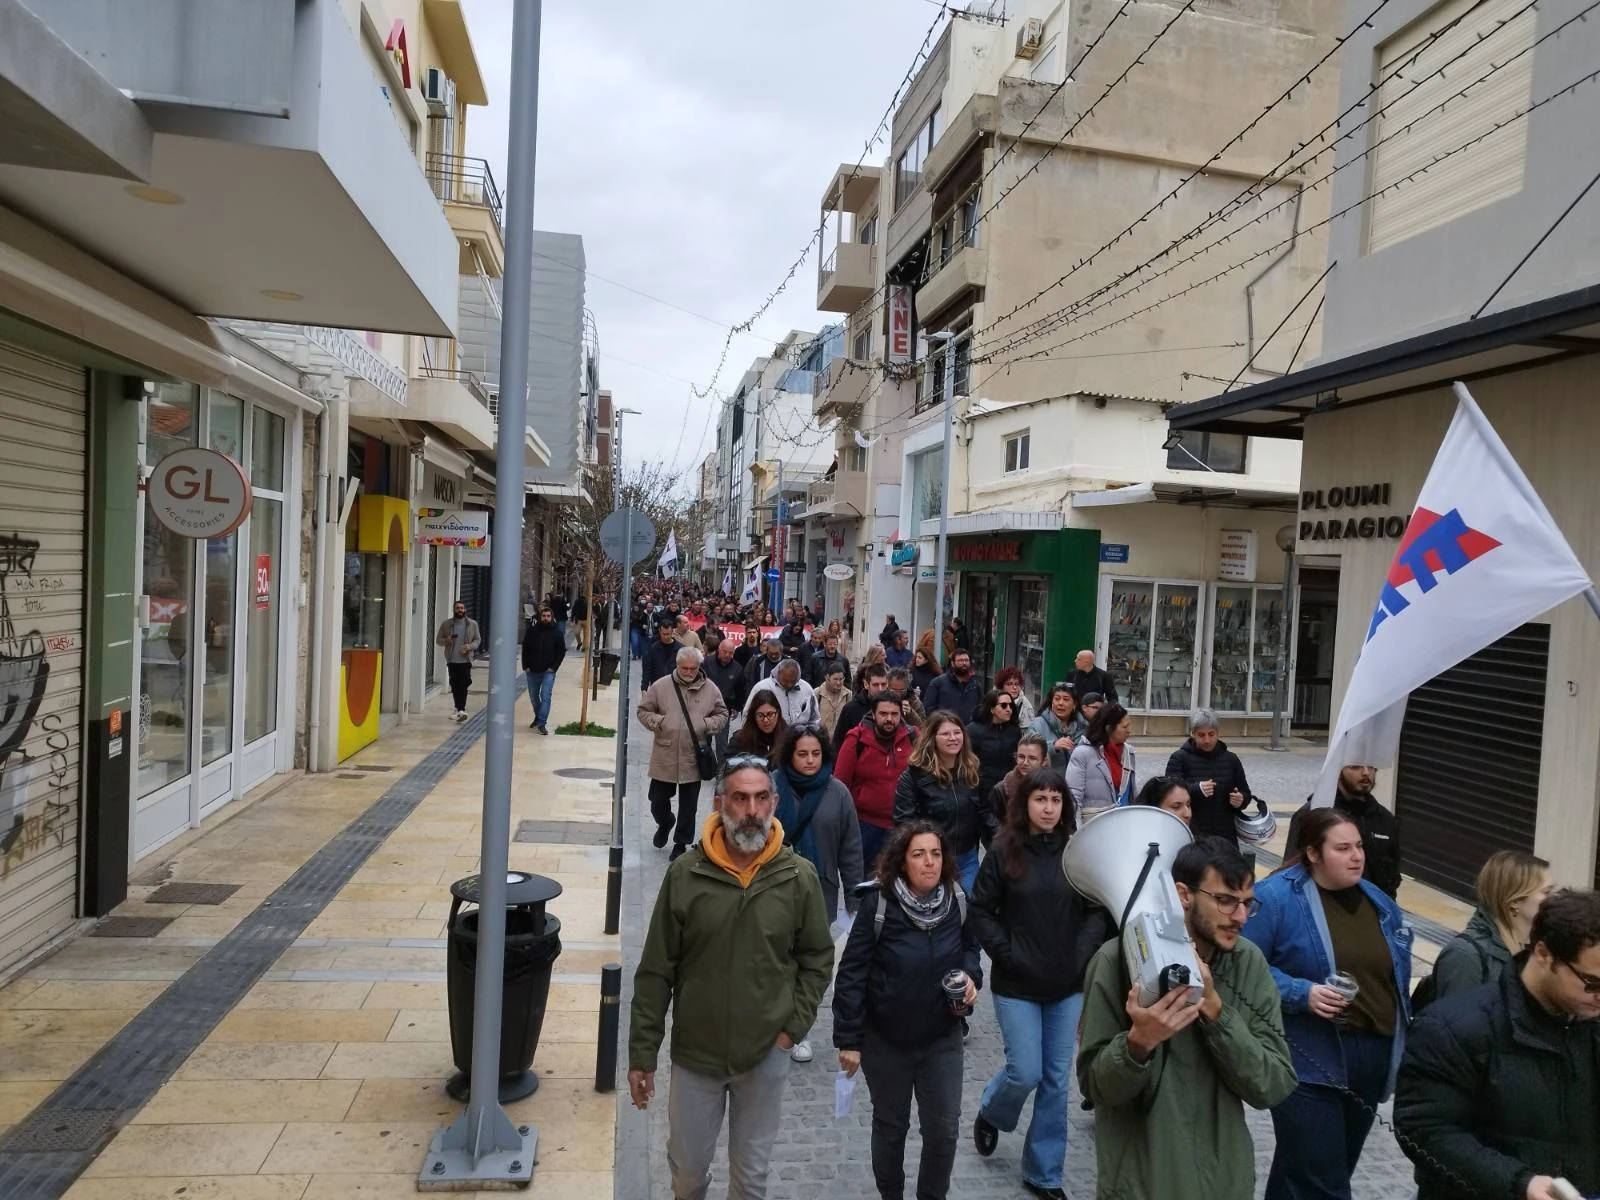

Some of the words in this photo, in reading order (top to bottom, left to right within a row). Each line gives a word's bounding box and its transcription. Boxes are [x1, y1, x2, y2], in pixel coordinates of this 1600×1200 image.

[164, 465, 230, 504] GL
[1301, 483, 1391, 510] PLOUMI
[164, 507, 225, 528] ACCESSORIES
[1299, 515, 1412, 540] PARAGIO
